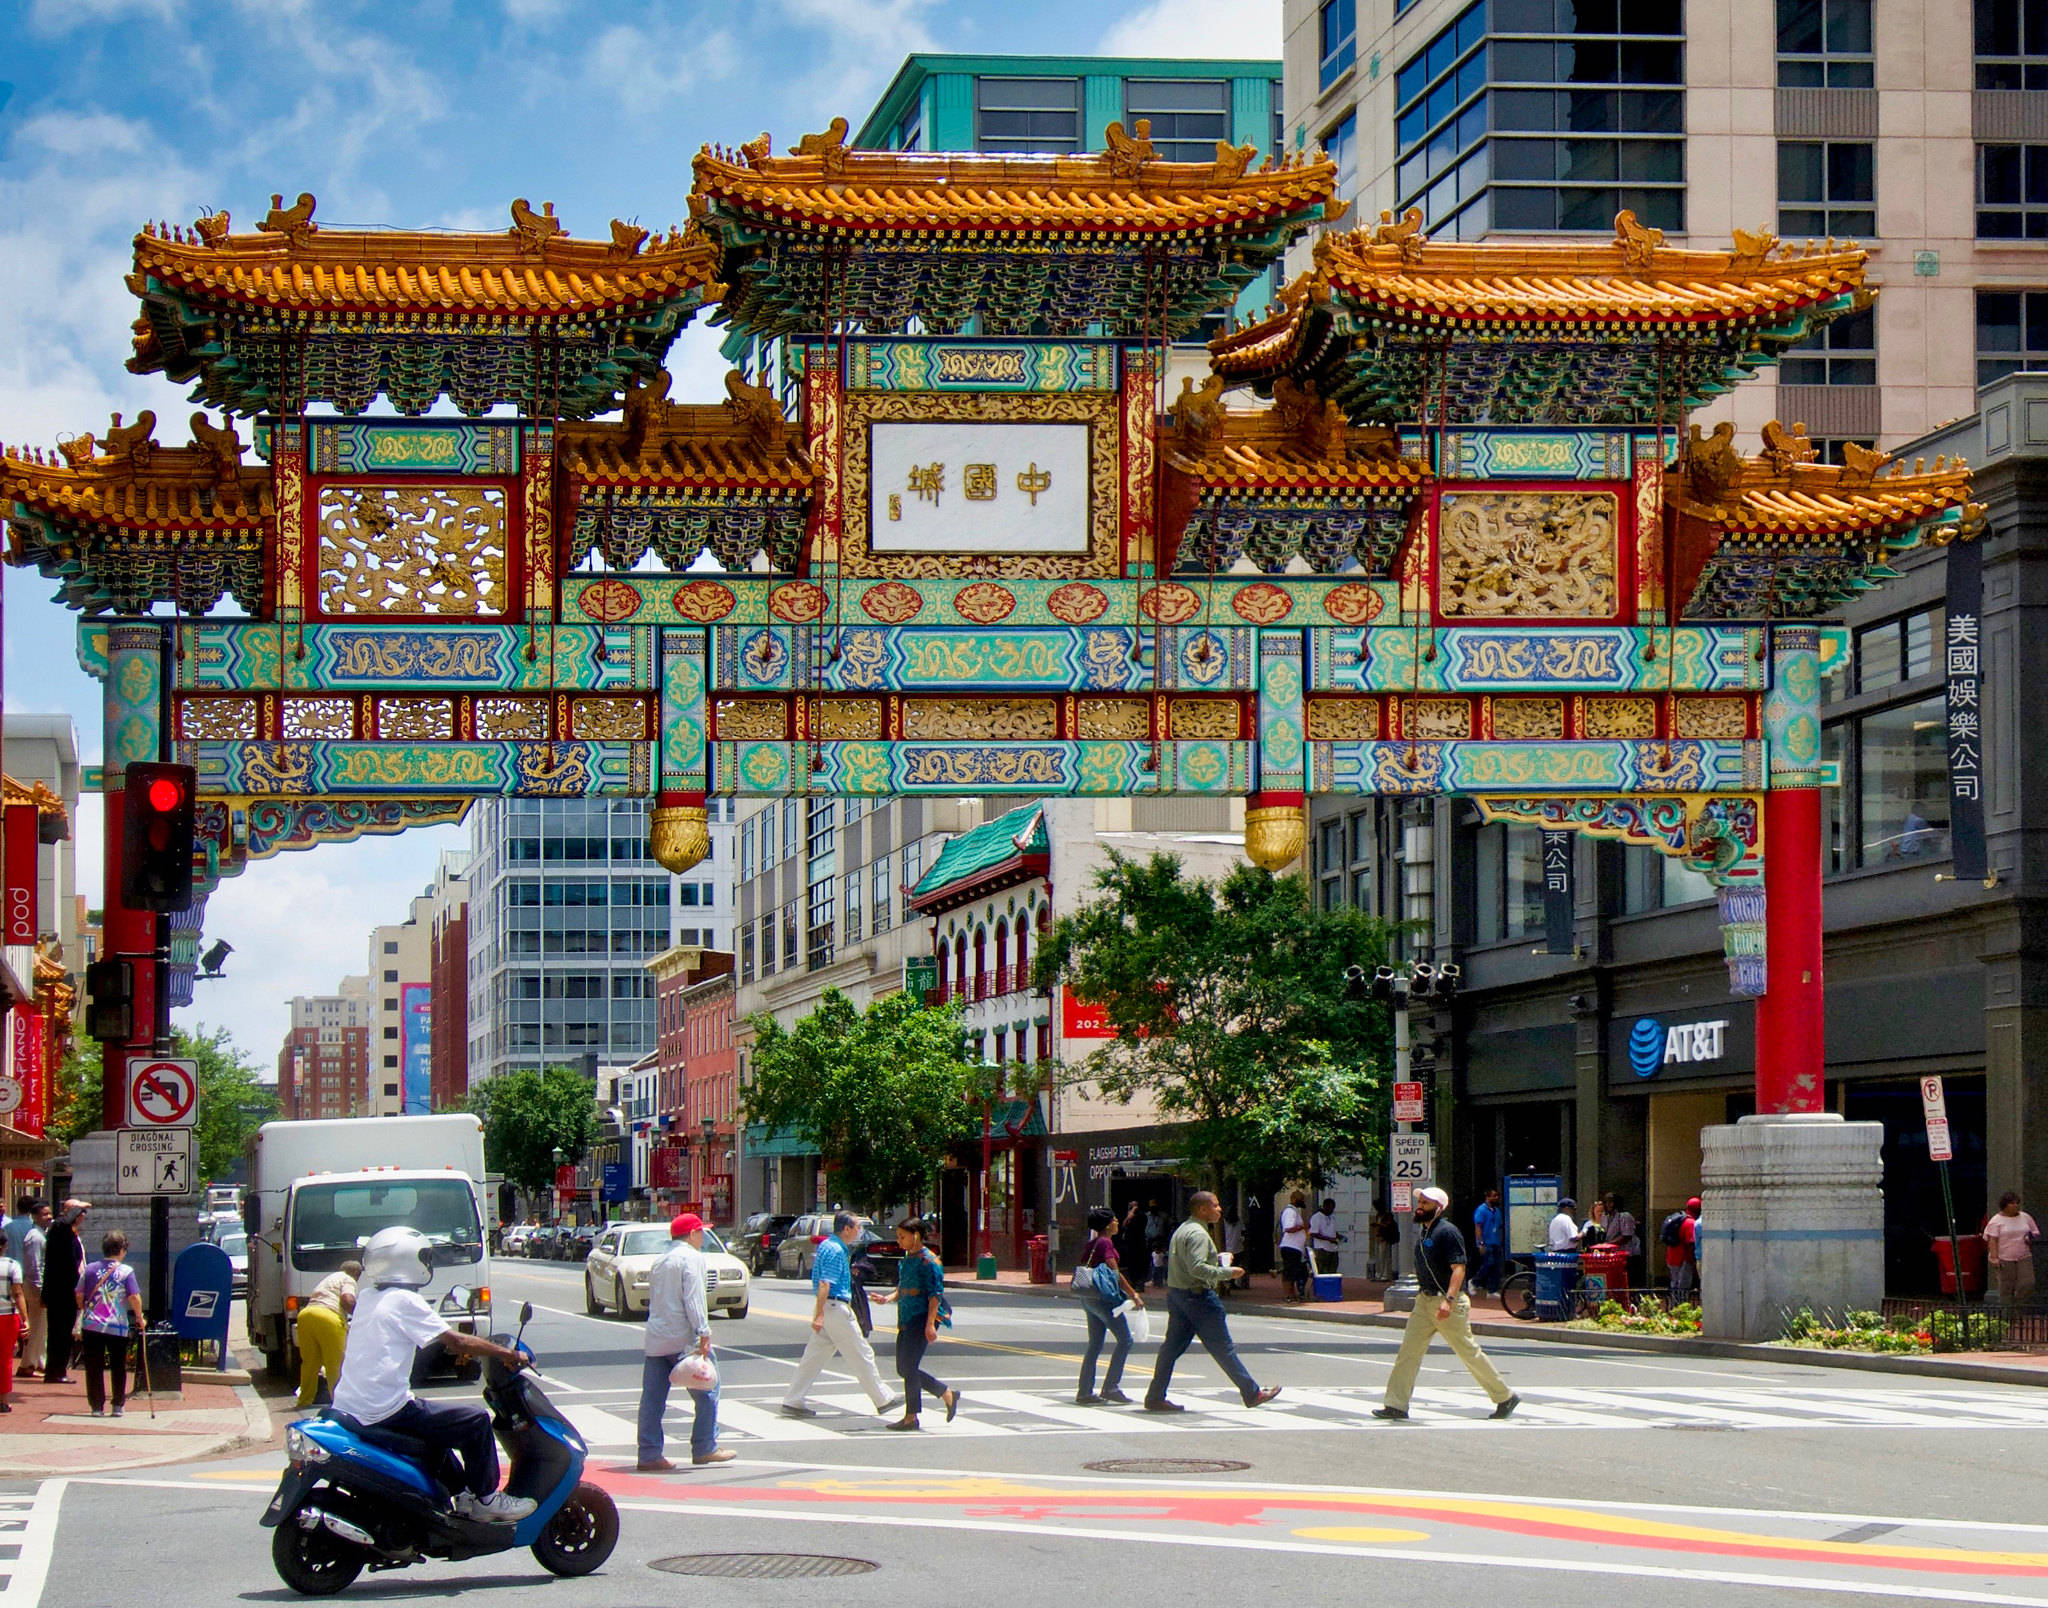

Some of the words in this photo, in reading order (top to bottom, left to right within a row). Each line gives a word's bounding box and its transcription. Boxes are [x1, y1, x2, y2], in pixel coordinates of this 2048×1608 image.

[1947, 613, 1980, 801] 美國娛樂公司
[8, 887, 33, 937] pod
[1663, 1020, 1729, 1064] AT&T
[16, 1016, 27, 1087] APIANO
[131, 1133, 175, 1142] DIAGONAL
[1395, 1138, 1425, 1146] SPEED
[130, 1142, 173, 1152] CROSSING
[1089, 1147, 1118, 1160] FLAGSHIP
[1119, 1144, 1141, 1158] RETAIL
[1398, 1147, 1421, 1156] LIMIT
[122, 1165, 139, 1178] OK
[1396, 1160, 1423, 1178] 25
